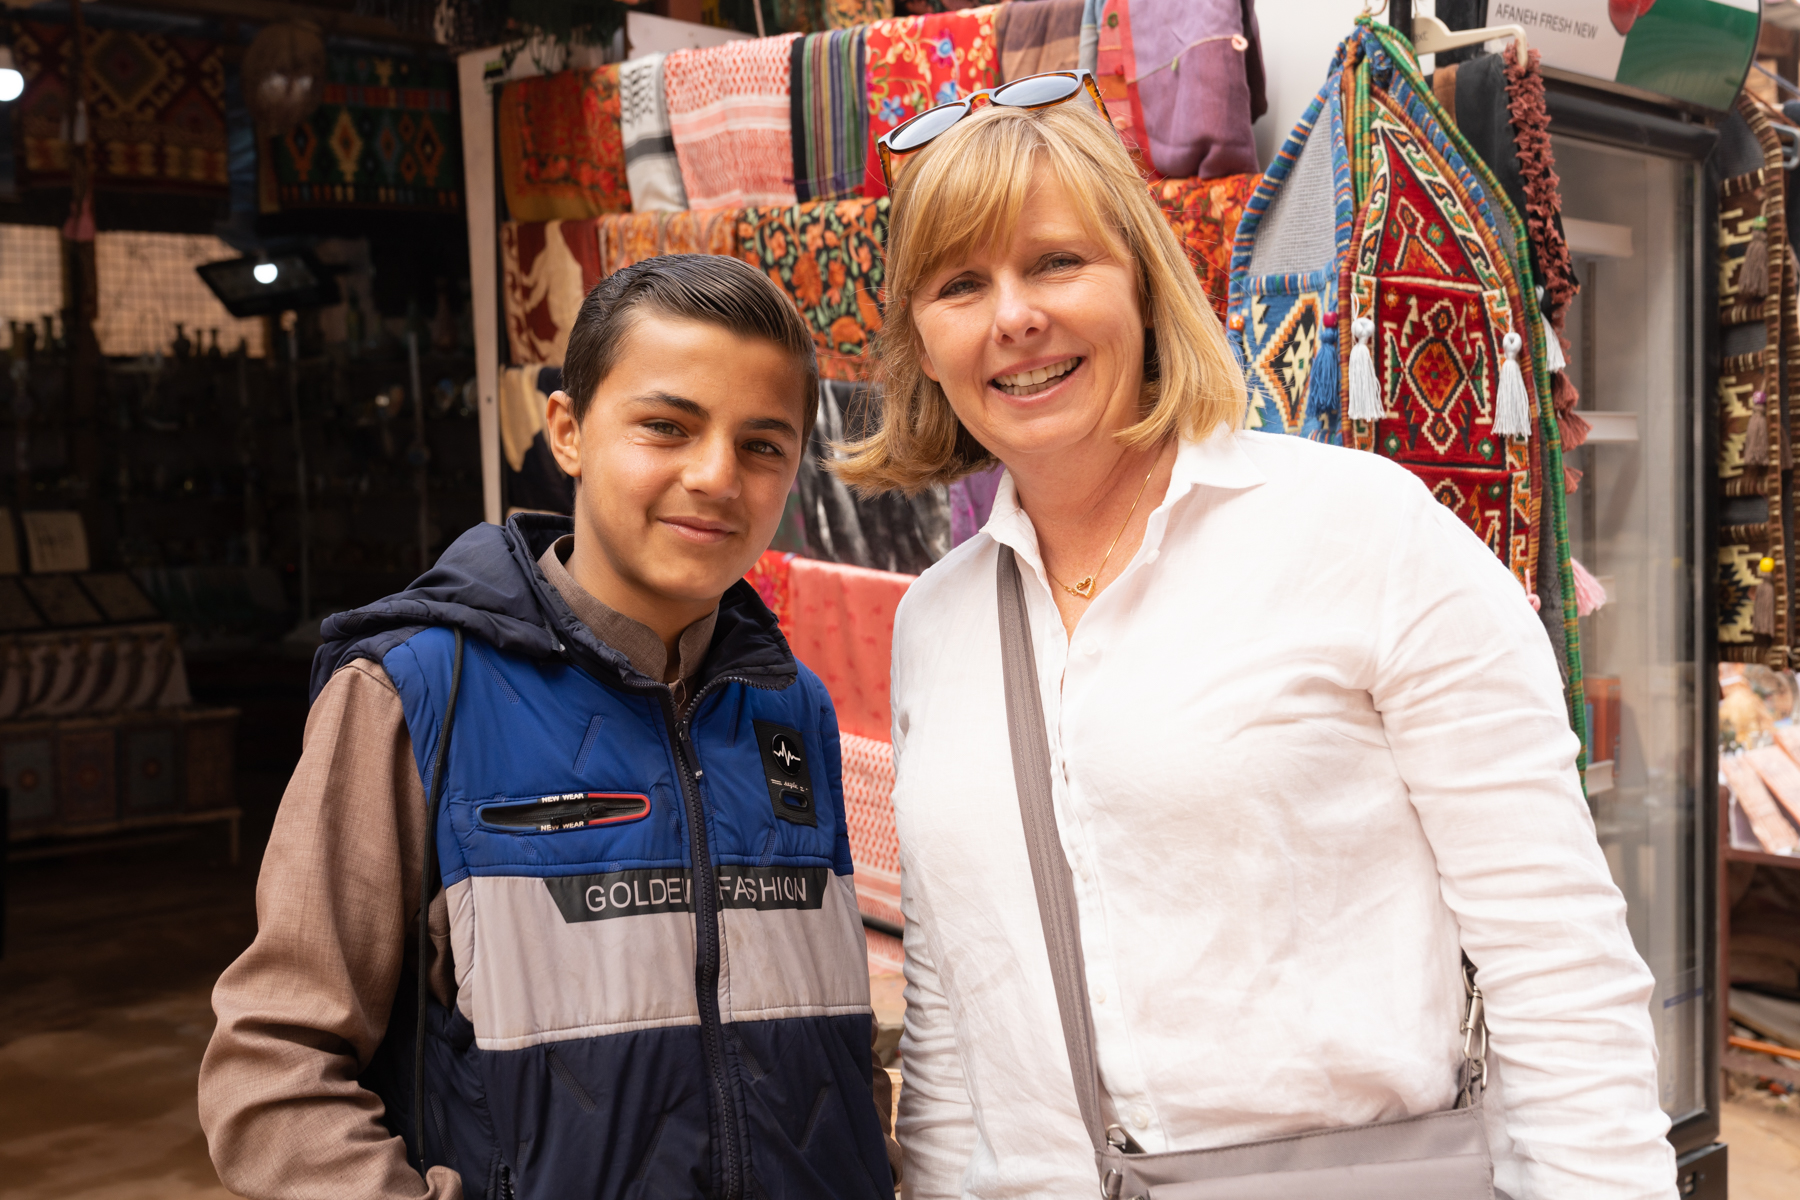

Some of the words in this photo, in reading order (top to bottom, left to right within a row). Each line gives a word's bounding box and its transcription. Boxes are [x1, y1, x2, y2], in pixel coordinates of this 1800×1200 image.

[1495, 3, 1538, 26] AFANEH
[1539, 12, 1573, 34] FRESH
[1573, 21, 1598, 39] NEW
[541, 795, 560, 803] NEW
[562, 793, 584, 801] WEAR
[562, 820, 584, 829] WEAR
[719, 876, 808, 903] FASHION
